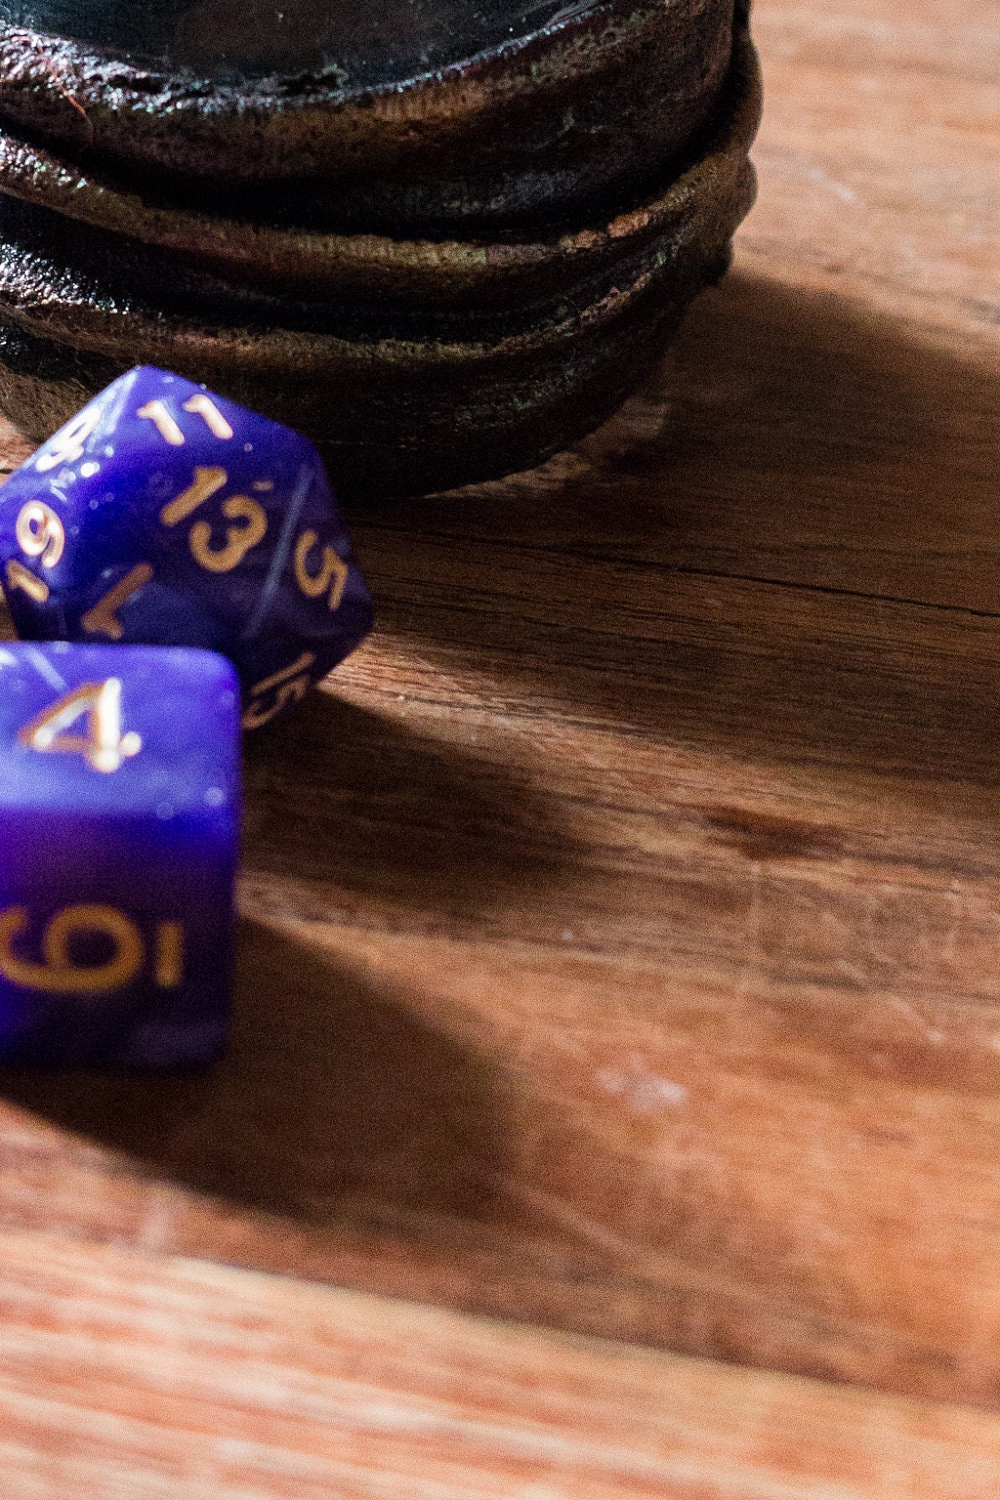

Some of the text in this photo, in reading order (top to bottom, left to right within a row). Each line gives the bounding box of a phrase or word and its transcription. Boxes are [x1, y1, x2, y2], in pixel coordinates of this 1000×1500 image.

[136, 394, 234, 446] 11
[159, 465, 268, 573] 13
[294, 530, 348, 612] 5
[18, 676, 142, 773] 4
